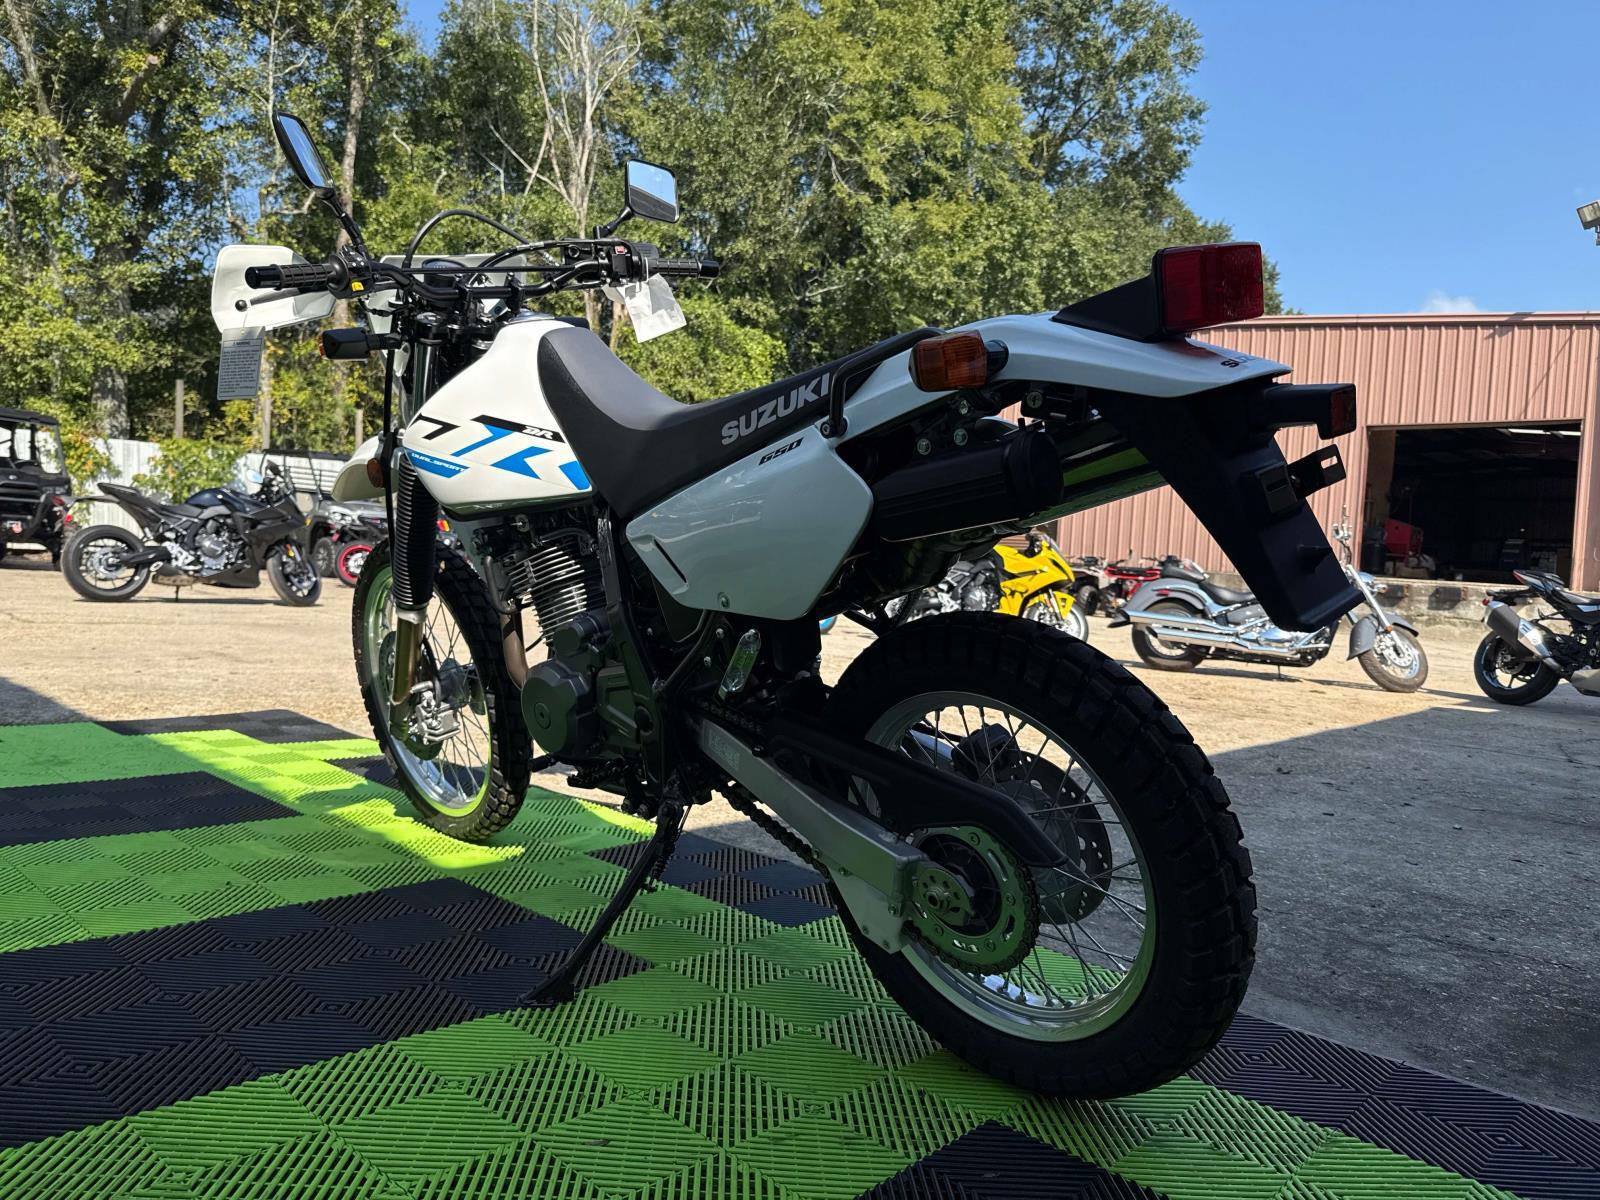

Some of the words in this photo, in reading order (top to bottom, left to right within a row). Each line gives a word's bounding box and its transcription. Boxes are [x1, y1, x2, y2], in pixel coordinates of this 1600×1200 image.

[721, 372, 830, 446] SUZUKI
[522, 425, 554, 440] DR
[758, 437, 804, 466] 650
